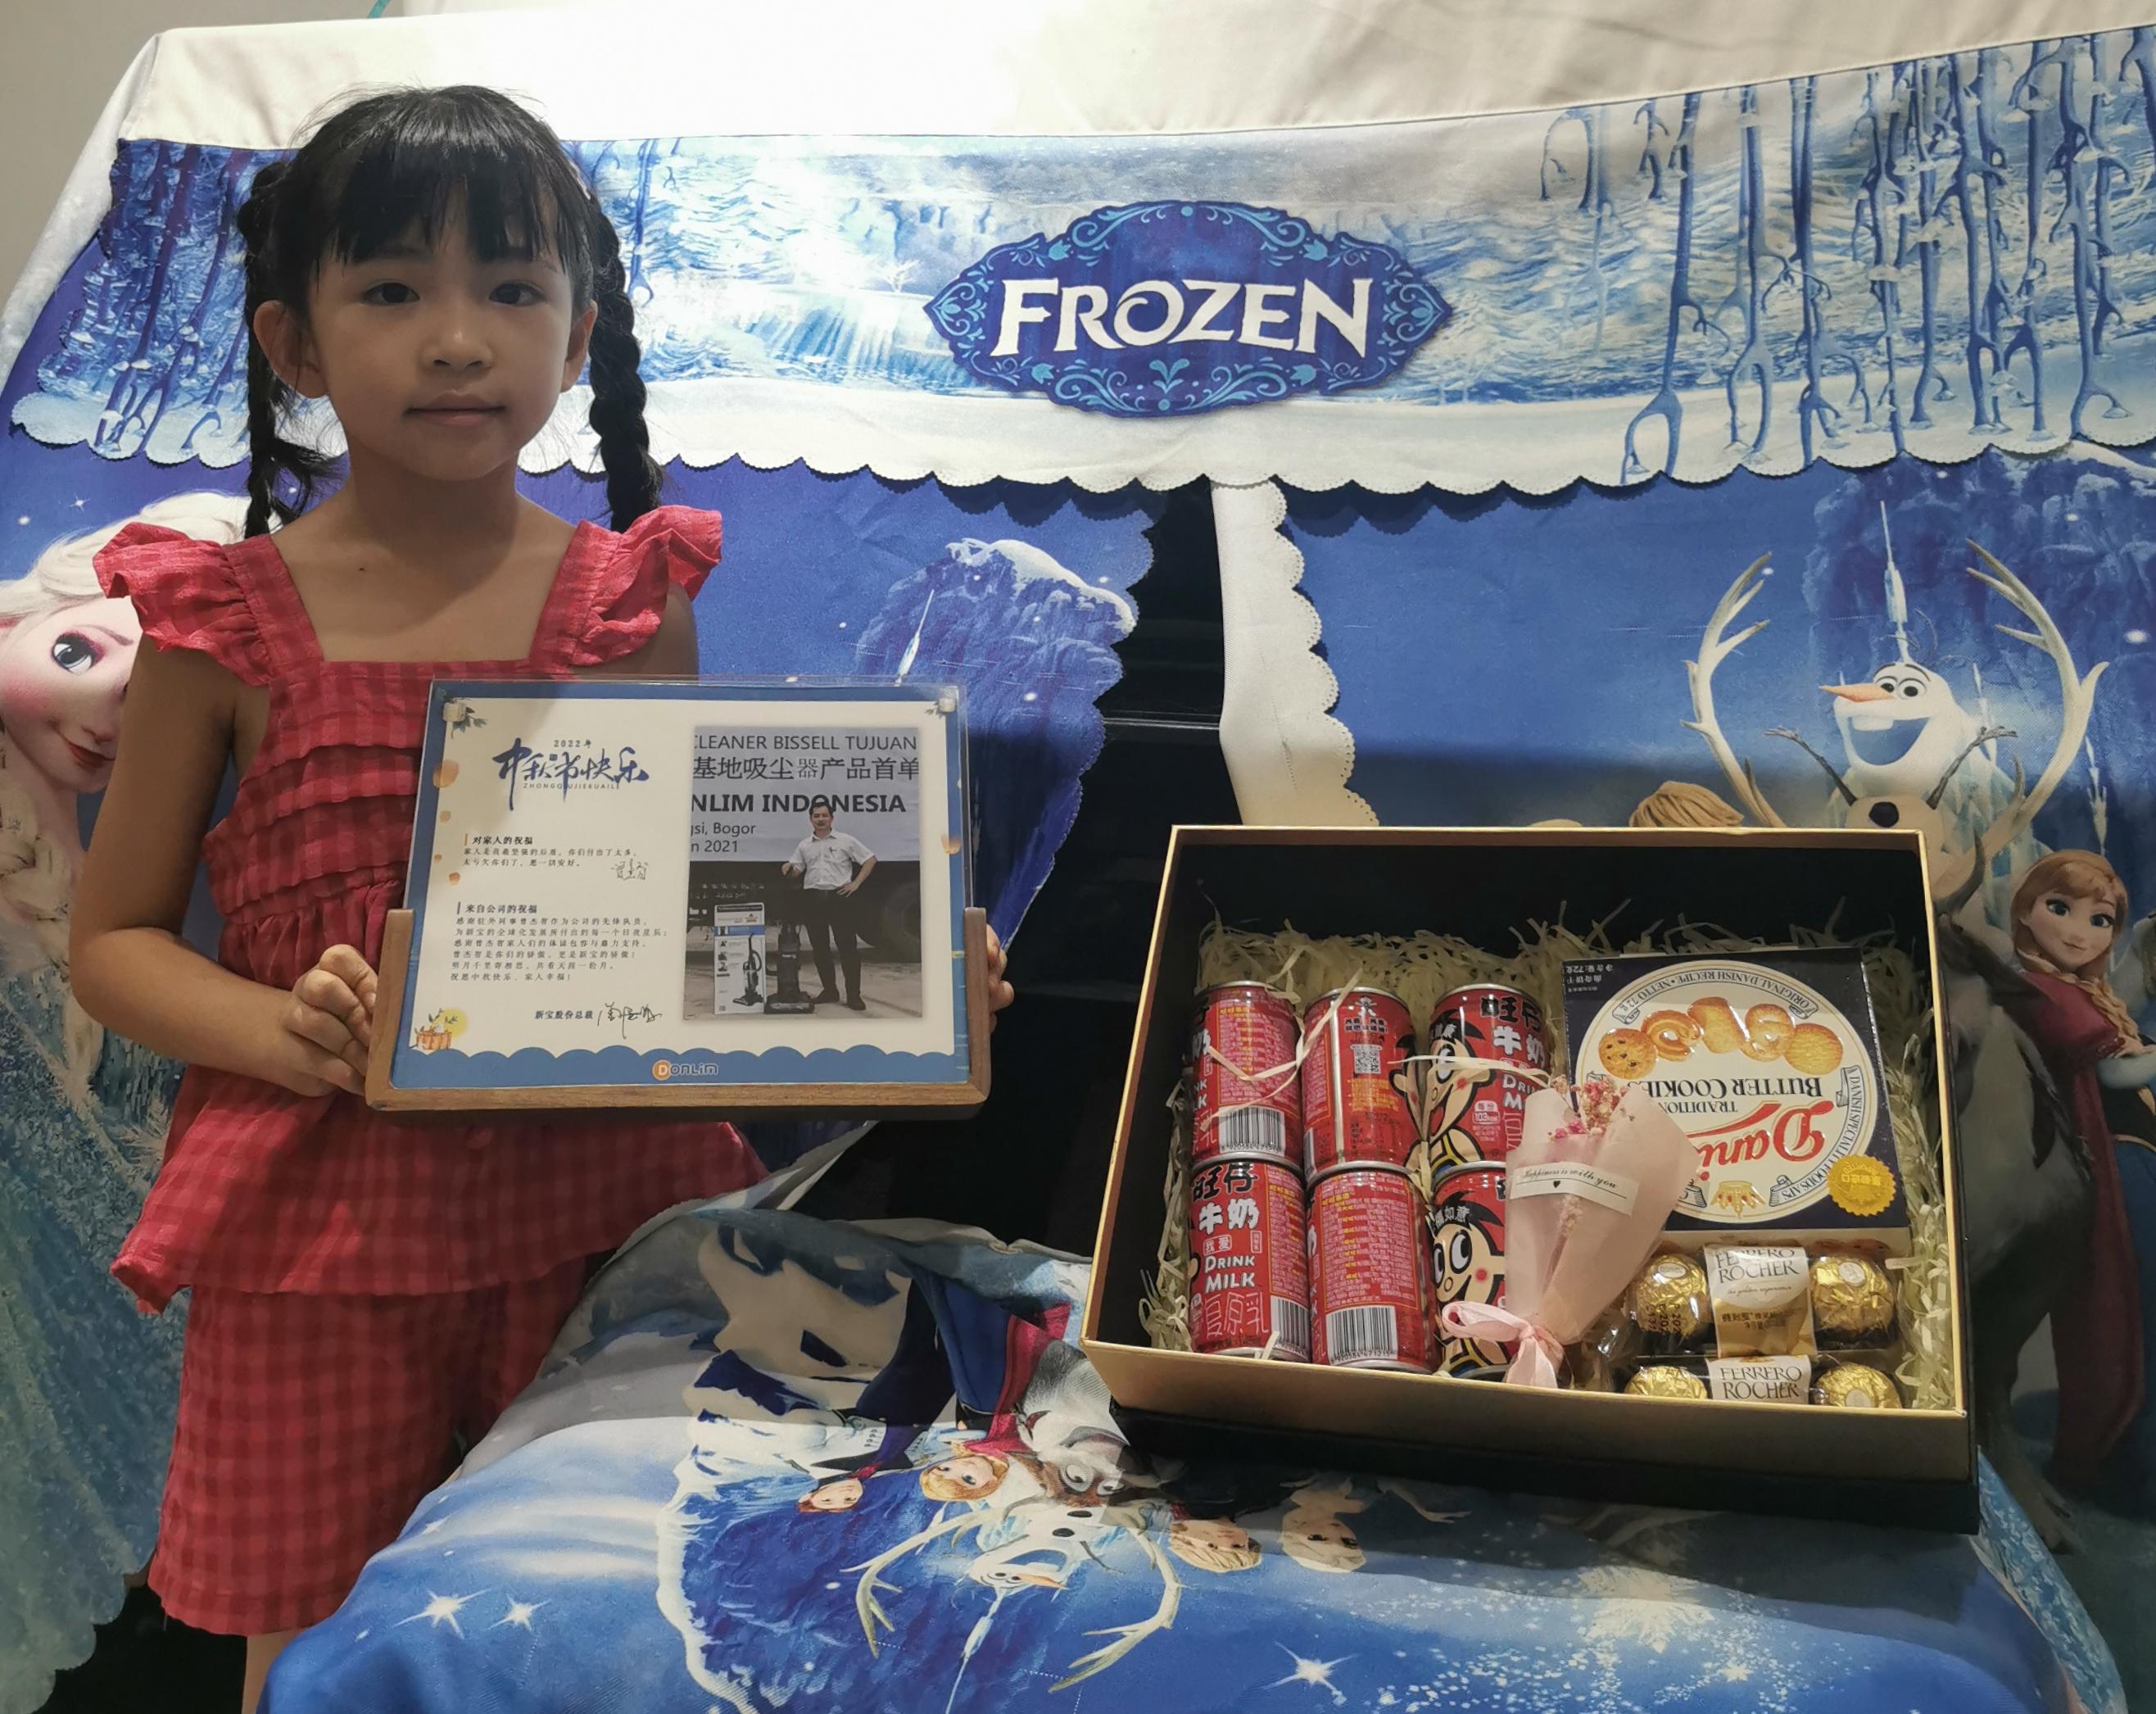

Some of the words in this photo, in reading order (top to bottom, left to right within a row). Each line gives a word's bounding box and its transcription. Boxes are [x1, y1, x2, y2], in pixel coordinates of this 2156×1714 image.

[990, 277, 1371, 358] FROZEN
[554, 739, 591, 749] 2022年
[773, 736, 840, 750] BISSELL
[845, 736, 916, 750] TUJUAN
[492, 737, 650, 811] 中秋节快乐
[693, 756, 919, 780] 基地吸尘器产品首单
[762, 794, 906, 813] INDONESIA
[713, 823, 756, 837] Bogor
[473, 836, 533, 846] 对家人的祝福
[704, 840, 738, 853] 2021
[465, 905, 537, 914] 来自公司的祝福
[1679, 970, 1716, 984] RECIPE
[1718, 970, 1760, 985] DANISH
[1637, 980, 1672, 1000] NETTO
[1762, 977, 1810, 1009] ORIGINAL
[1493, 1025, 1544, 1068] 牛奶
[1502, 1074, 1539, 1095] DRI
[1628, 1077, 1727, 1098] COOKIE
[1731, 1077, 1823, 1097] BUTTER
[1850, 1076, 1864, 1113] DANISH
[1193, 1162, 1257, 1202] 旺仔
[1524, 1168, 1559, 1179] Happiness
[1569, 1169, 1595, 1180] with
[1594, 1177, 1618, 1189] you
[1199, 1198, 1260, 1235] 牛奶
[1205, 1254, 1255, 1273] DRINK
[1719, 1260, 1800, 1283] ROCHER
[1206, 1272, 1256, 1293] MILK
[1720, 1365, 1802, 1381] FERRERO
[1723, 1381, 1800, 1399] ROCHER
